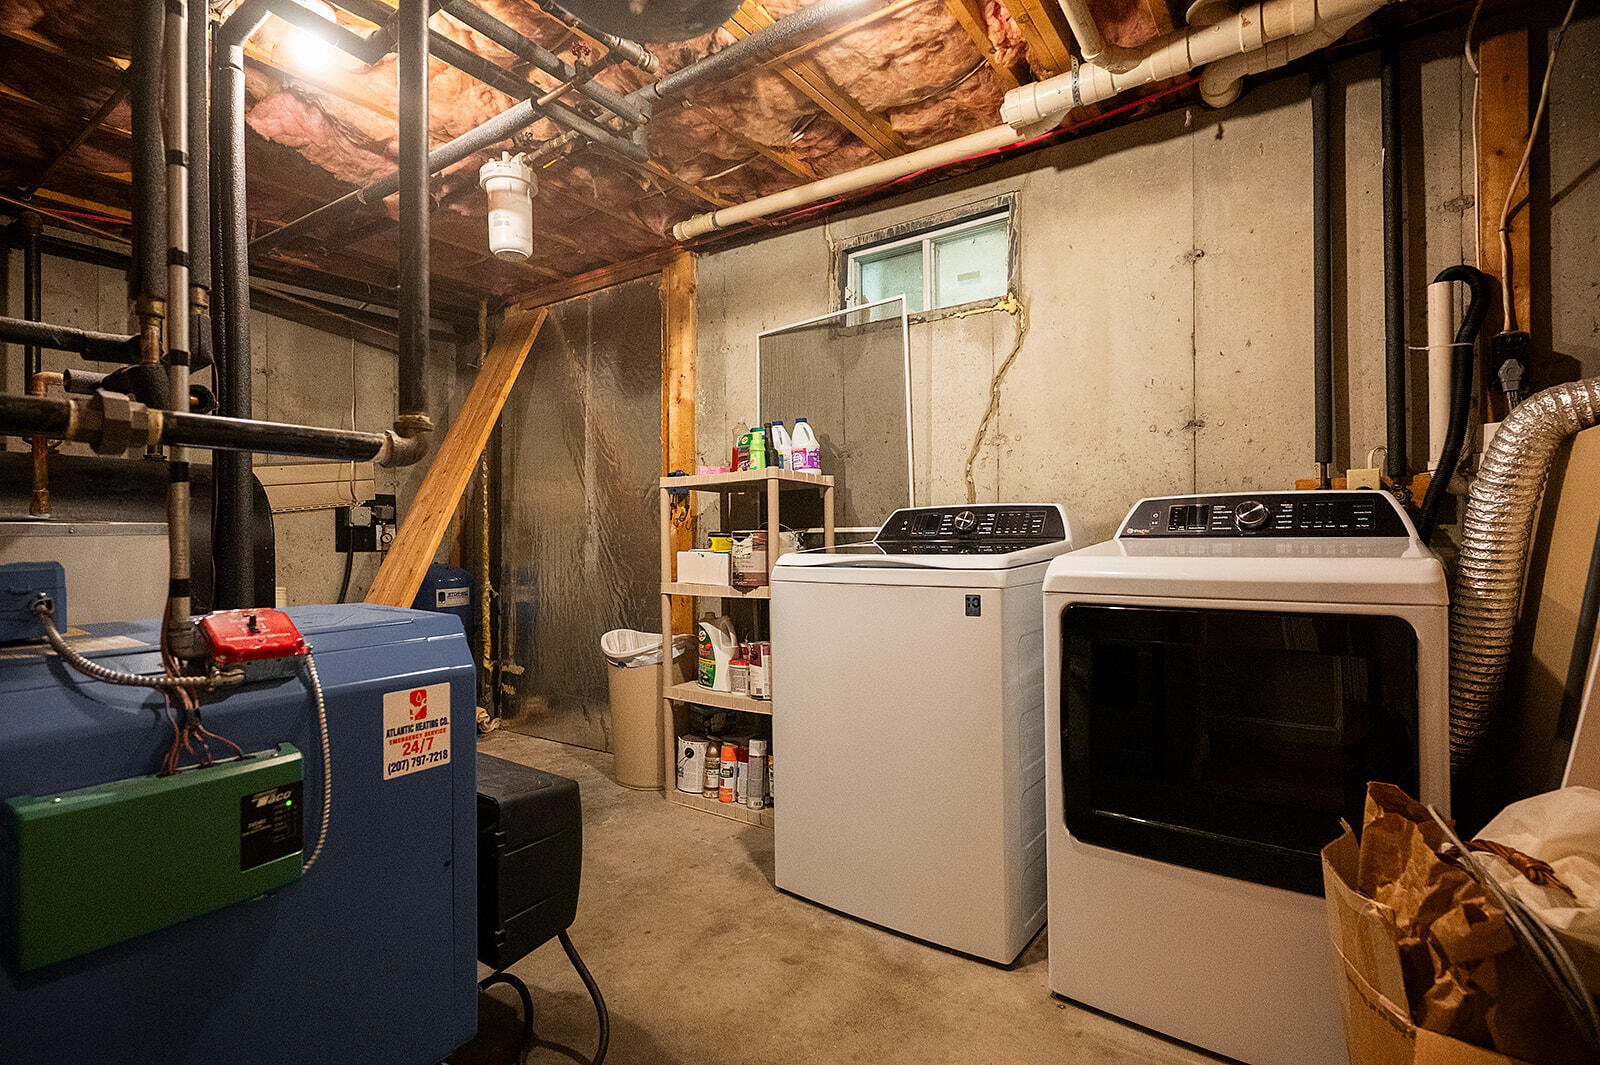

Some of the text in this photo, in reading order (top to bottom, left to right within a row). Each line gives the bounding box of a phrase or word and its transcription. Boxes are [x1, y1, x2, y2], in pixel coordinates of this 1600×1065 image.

[386, 717, 448, 738] ATLANTIC HEATING CO.
[389, 728, 446, 745] EMERGENCY SERVICE
[402, 737, 434, 757] 24/7
[388, 749, 448, 776] (207) 797-7218
